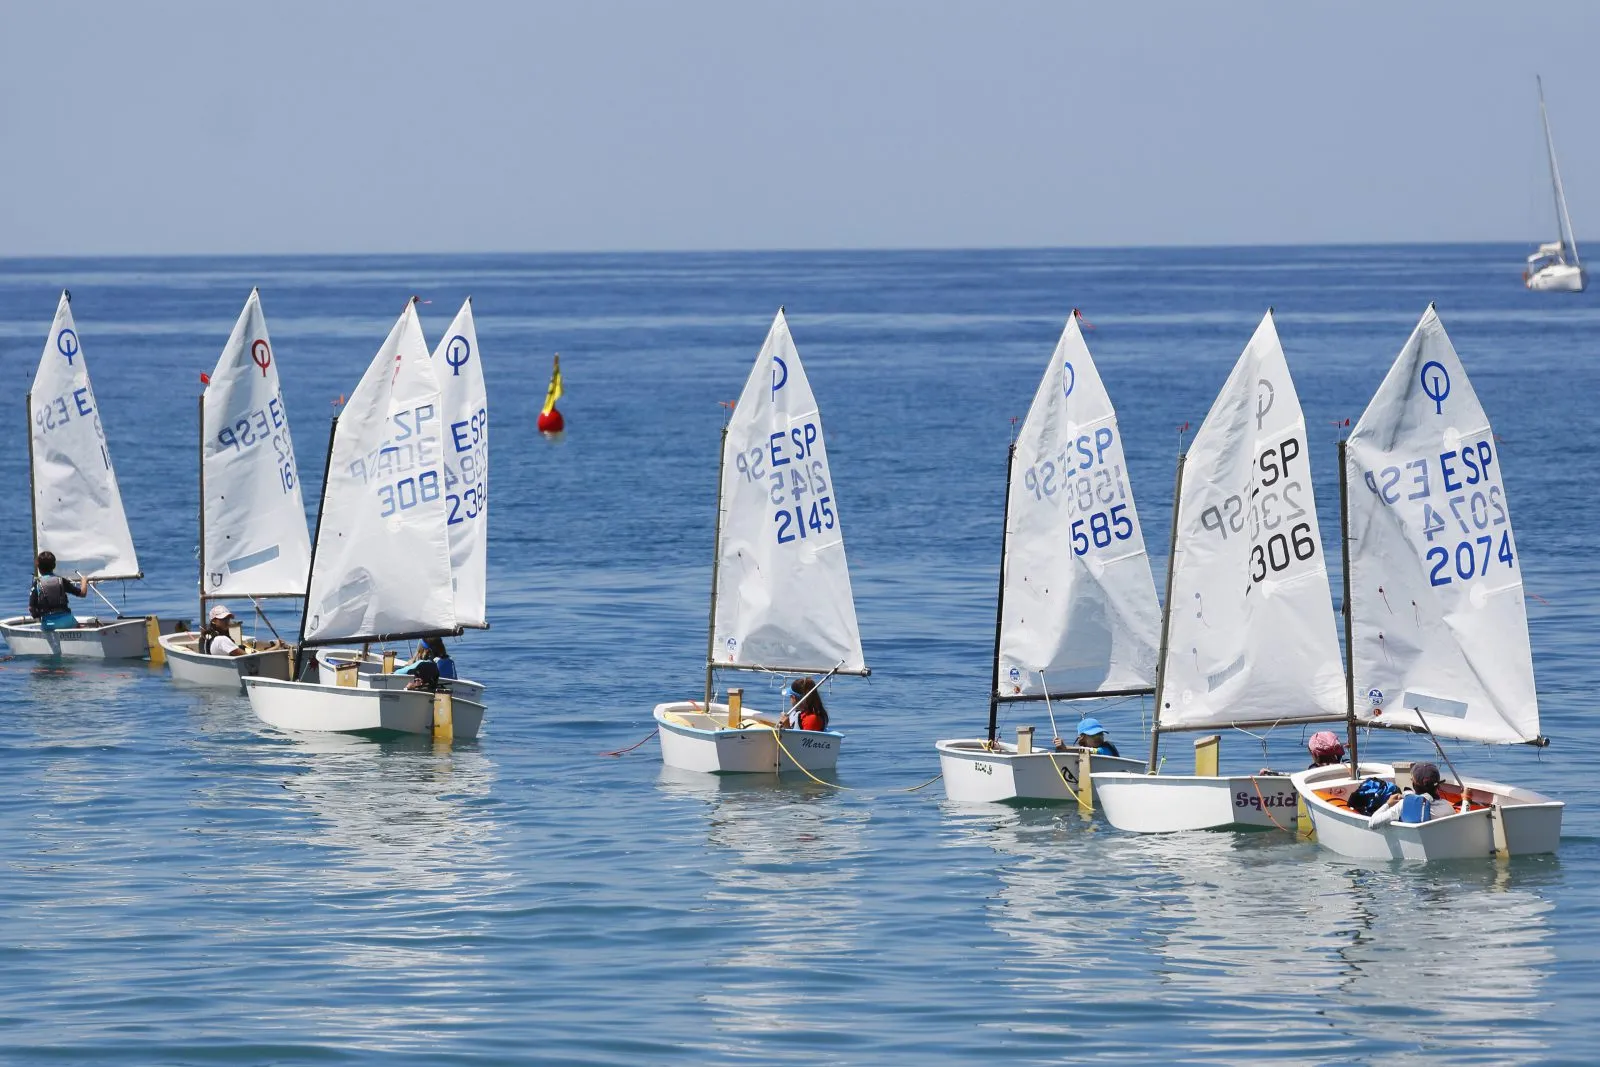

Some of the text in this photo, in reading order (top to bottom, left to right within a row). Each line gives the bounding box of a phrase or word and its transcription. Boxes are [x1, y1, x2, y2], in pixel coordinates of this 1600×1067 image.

[387, 404, 435, 442] SP
[450, 408, 486, 453] ESP
[770, 423, 817, 466] ESP
[1252, 438, 1299, 500] SP
[1440, 441, 1492, 493] ESP
[378, 470, 440, 518] 308
[445, 482, 486, 526] 238
[774, 496, 834, 544] 2145
[1069, 504, 1133, 560] 585
[1246, 522, 1315, 597] 306
[1426, 530, 1514, 587] 2074
[1235, 791, 1298, 811] Squid
